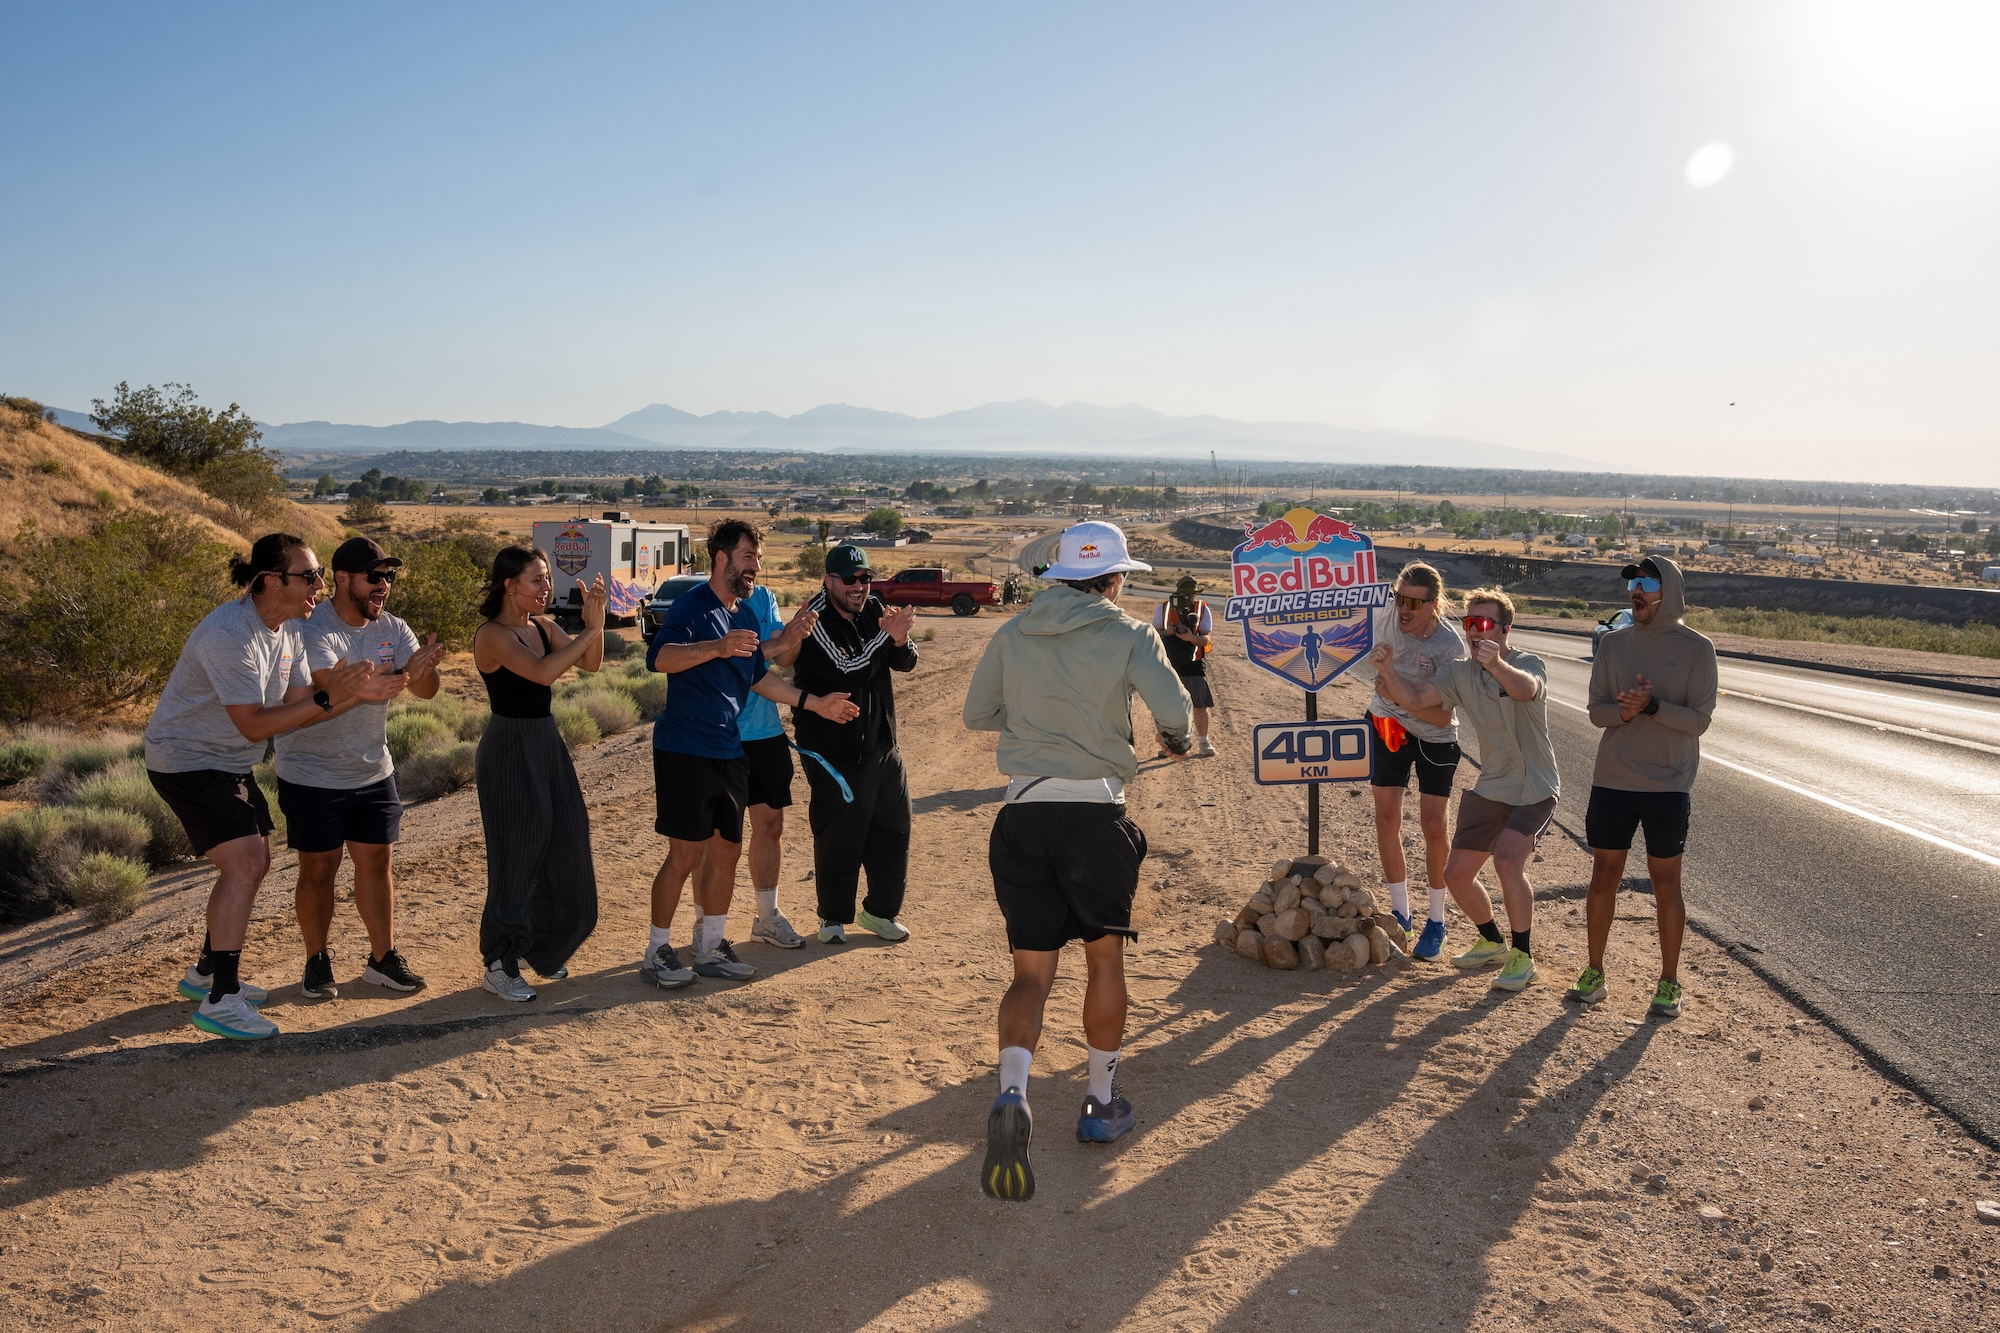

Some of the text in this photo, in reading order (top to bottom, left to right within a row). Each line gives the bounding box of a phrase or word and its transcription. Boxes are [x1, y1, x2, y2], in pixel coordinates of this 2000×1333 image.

[555, 542, 589, 551] Red Bull
[1233, 550, 1376, 596] Red Bull
[1228, 585, 1386, 619] CYBORG SEASON
[1265, 608, 1351, 626] ULTRA 600
[1261, 727, 1366, 764] 400
[1300, 766, 1329, 778] KM
